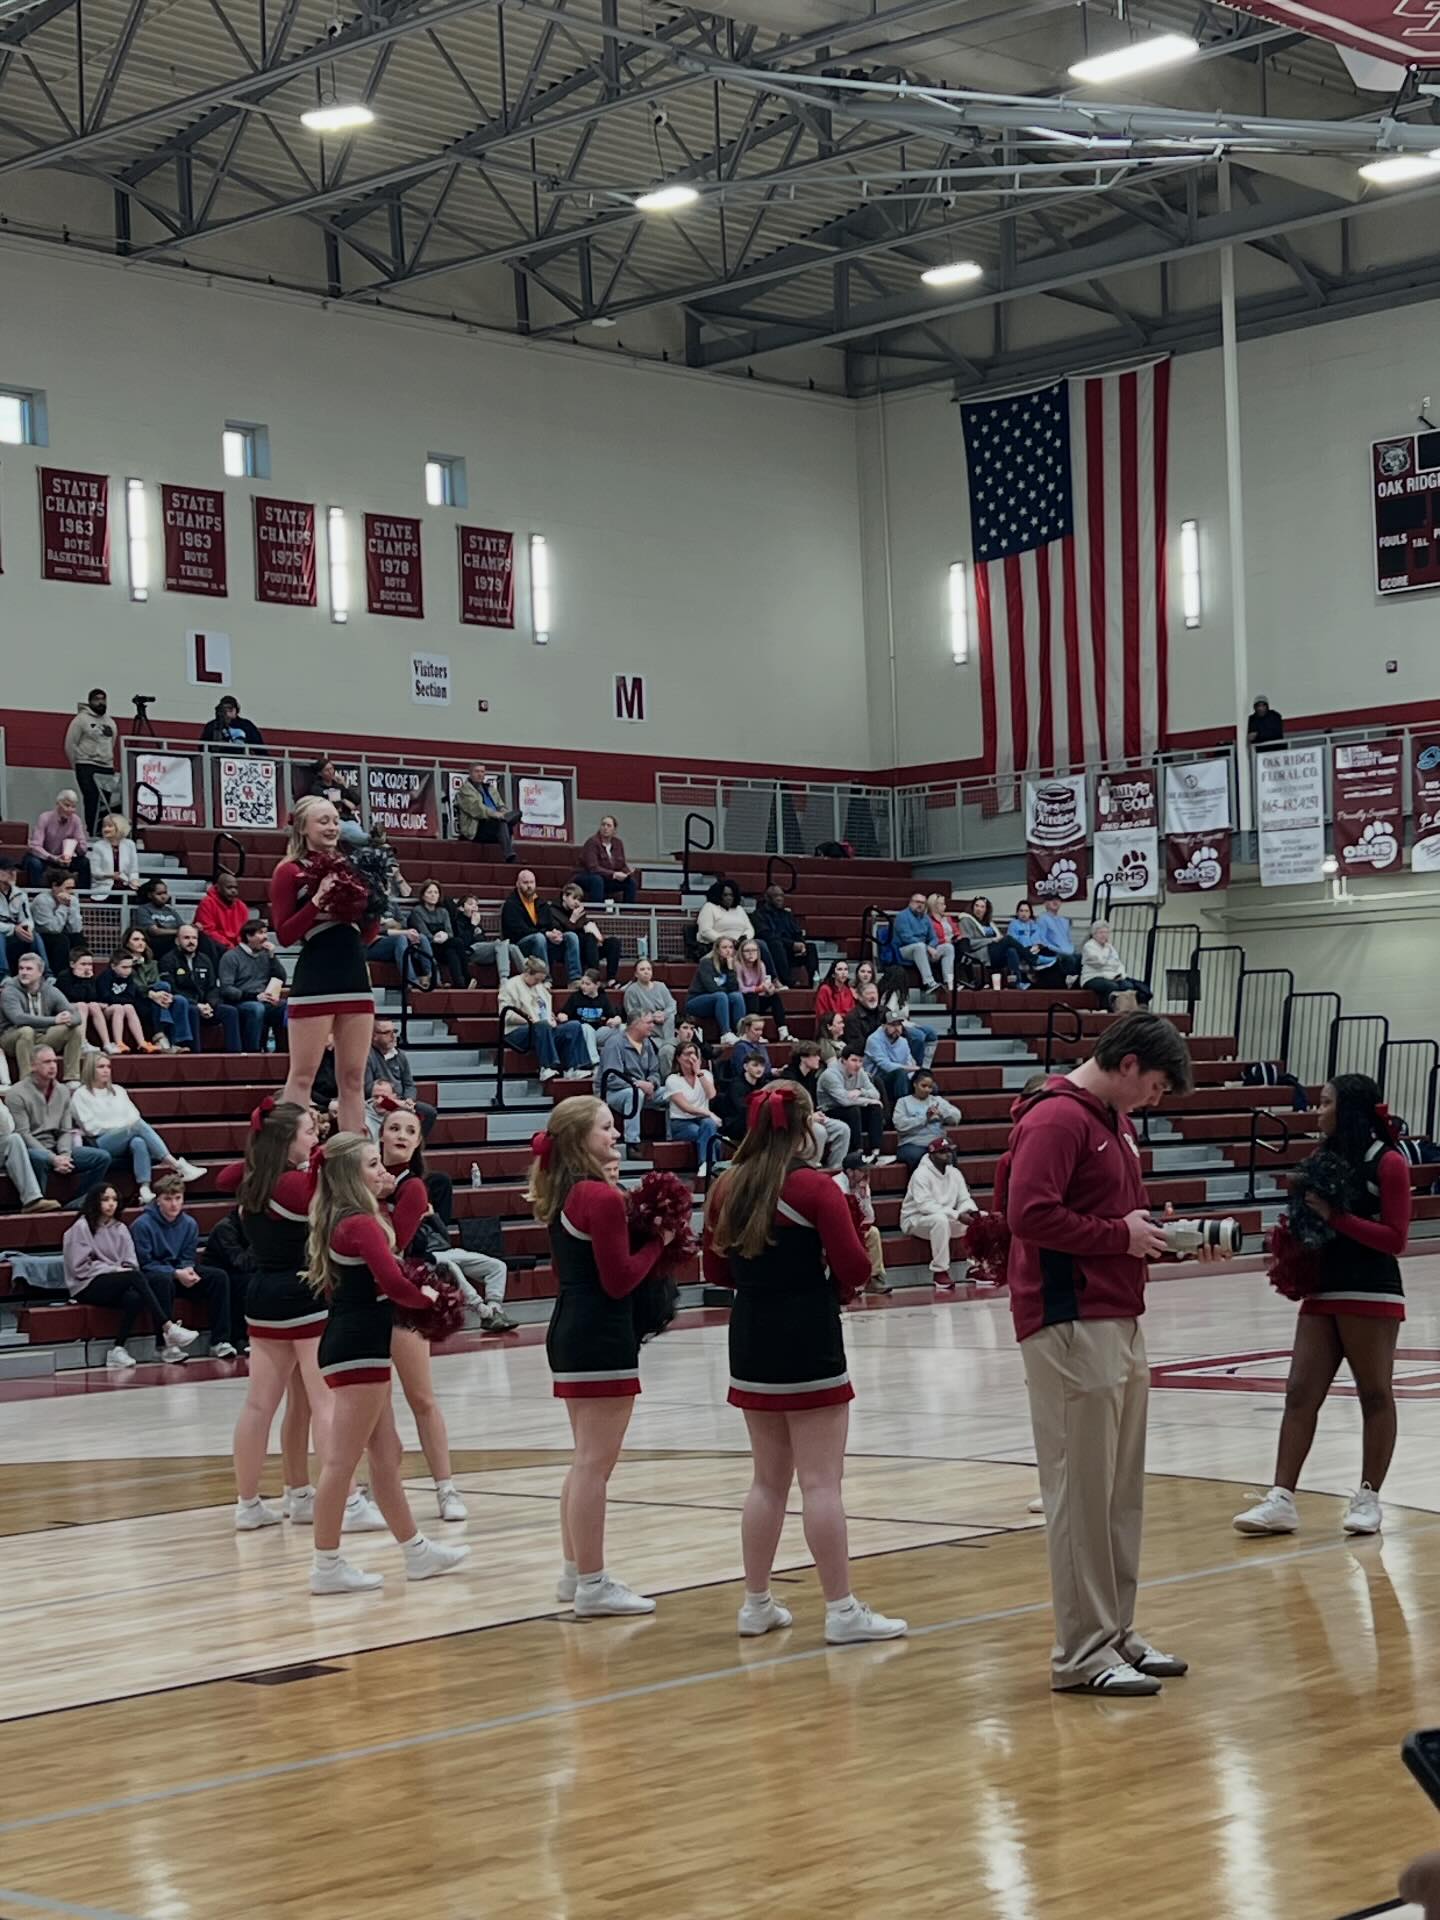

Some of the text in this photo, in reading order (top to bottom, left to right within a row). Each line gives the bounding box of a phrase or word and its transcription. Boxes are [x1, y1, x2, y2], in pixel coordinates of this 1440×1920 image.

[53, 478, 98, 498] STATE
[1378, 480, 1404, 497] OAK
[46, 496, 105, 517] CHAMPS
[172, 493, 215, 513] STATE
[166, 511, 222, 532] CHAMPS
[265, 507, 306, 526] STATE
[59, 518, 94, 536] 1963
[259, 526, 311, 546] CHAMPS
[373, 522, 413, 540] STATE
[64, 538, 90, 551] BOYS
[179, 531, 212, 549] 1963
[469, 535, 507, 553] STATE
[1379, 534, 1407, 548] FOULS
[47, 549, 108, 568] BASKETBALL
[185, 551, 208, 563] BOYS
[271, 549, 302, 567] 1975
[368, 541, 418, 558] CHAMPS
[180, 564, 213, 579] TENNIS
[464, 553, 512, 572] CHAMPS
[264, 571, 309, 587] FOOTBALL
[384, 577, 406, 589] BOYS
[474, 575, 502, 592] 1979
[1381, 575, 1409, 589] SCORE
[379, 590, 413, 602] SOCCER
[468, 596, 510, 611] FOOTBALL
[194, 634, 223, 684] L
[413, 659, 448, 679] Visitors
[414, 680, 448, 700] Section
[615, 676, 645, 721] M
[1283, 752, 1317, 767] RIDGE
[385, 773, 408, 790] CODE
[409, 774, 420, 791] TO
[1261, 768, 1300, 783] FLORAL
[369, 792, 410, 808] THE NEW
[371, 812, 400, 829] MEDIA
[400, 814, 428, 831] GUIDE
[1035, 878, 1074, 891] ORHS
[1103, 870, 1146, 883] ORHS
